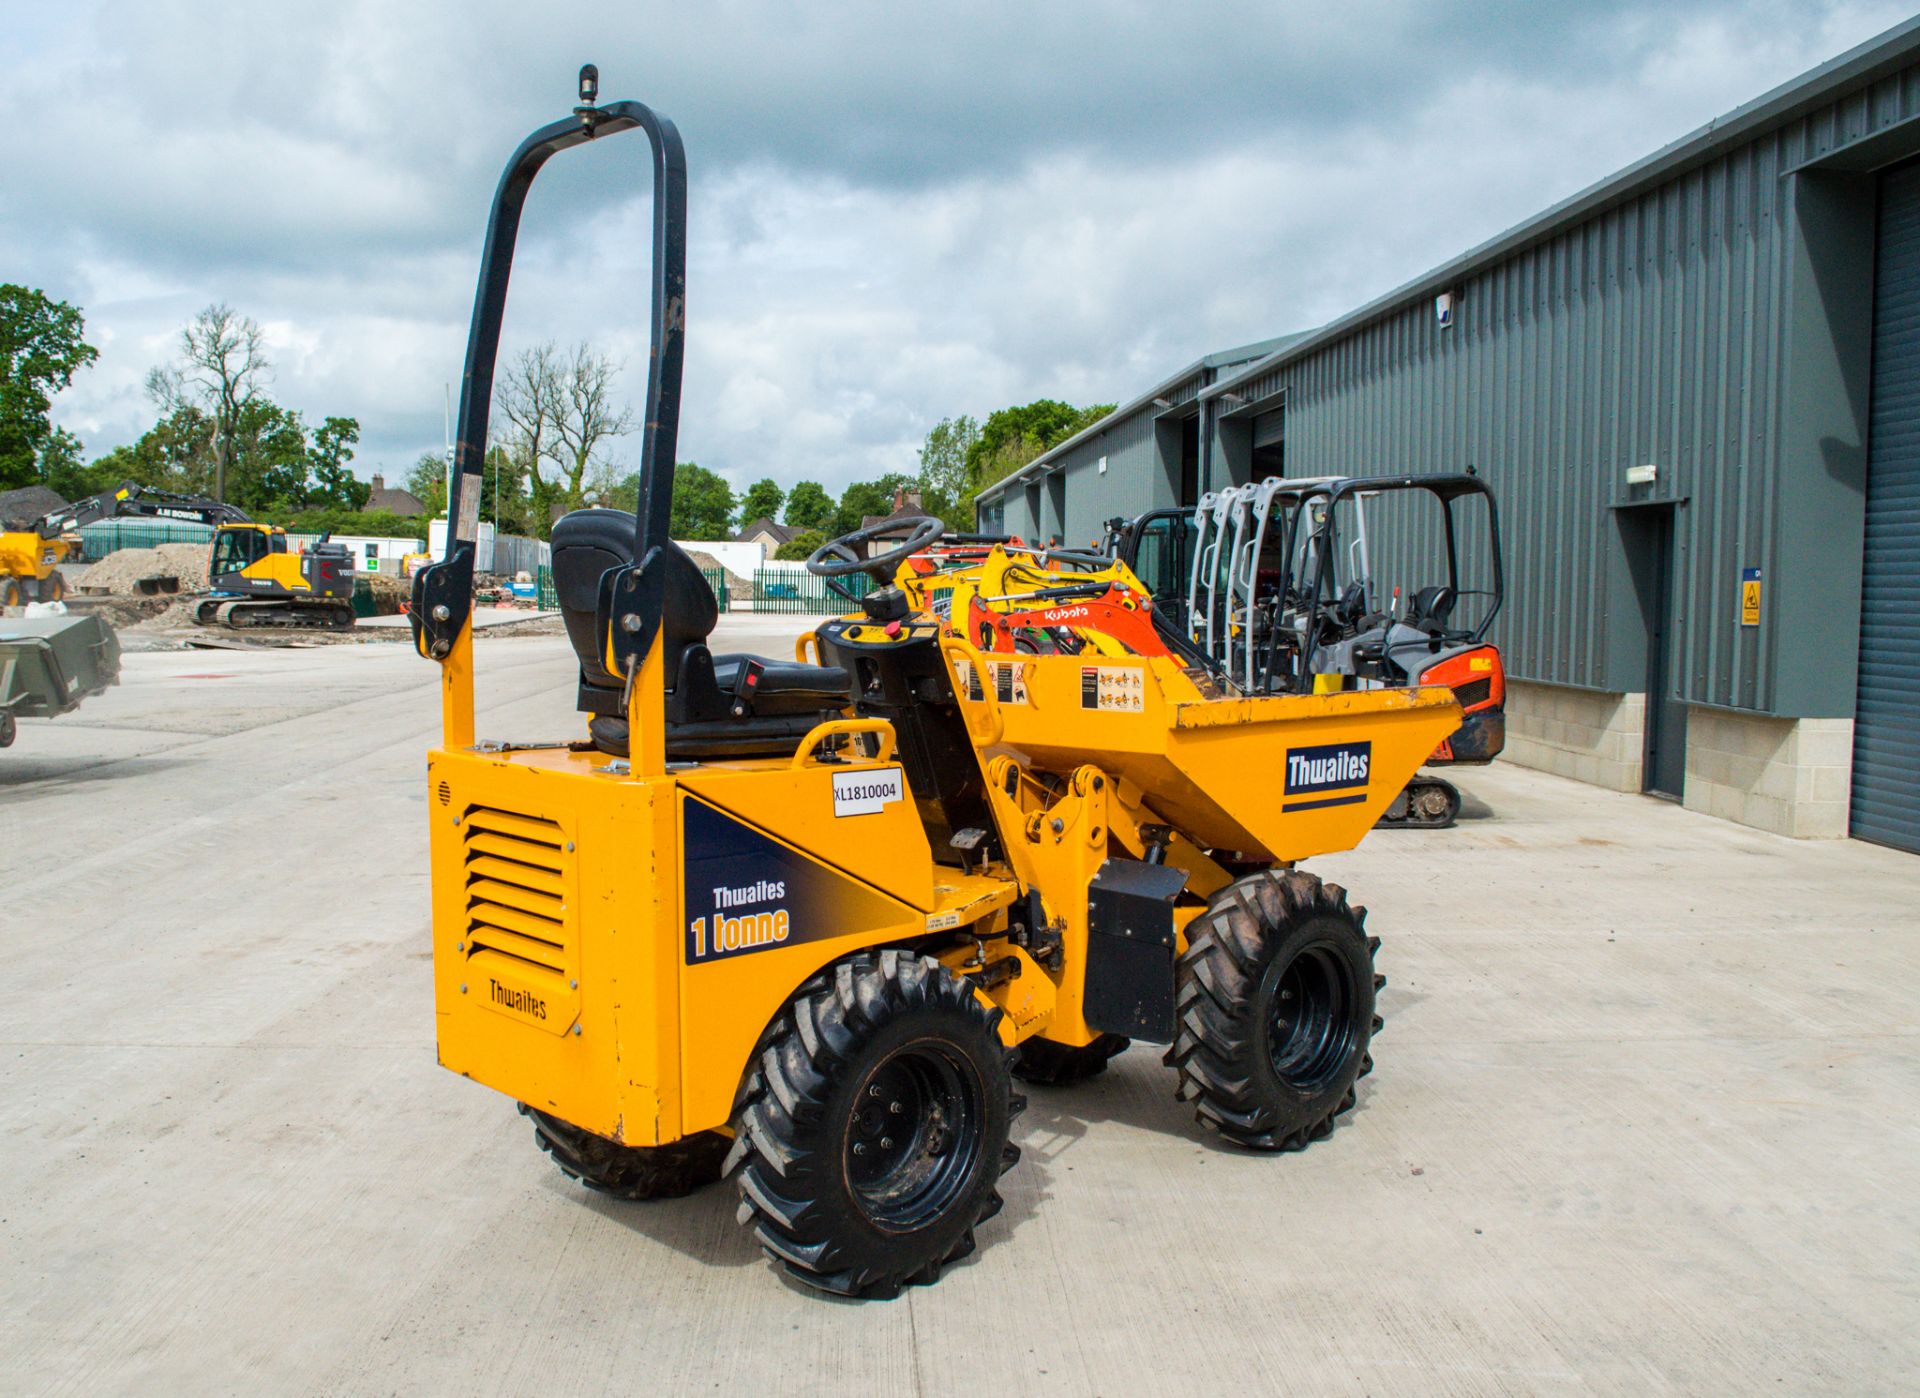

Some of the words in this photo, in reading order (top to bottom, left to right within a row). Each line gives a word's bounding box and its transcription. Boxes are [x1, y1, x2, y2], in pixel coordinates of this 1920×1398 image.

[1044, 605, 1088, 621] Kubota
[1288, 750, 1369, 787] Thwaites
[834, 783, 896, 802] XL1810004
[713, 880, 785, 909] Thwaites
[691, 916, 706, 957] 1
[713, 908, 789, 953] tonne
[489, 978, 547, 1021] Thwaites
